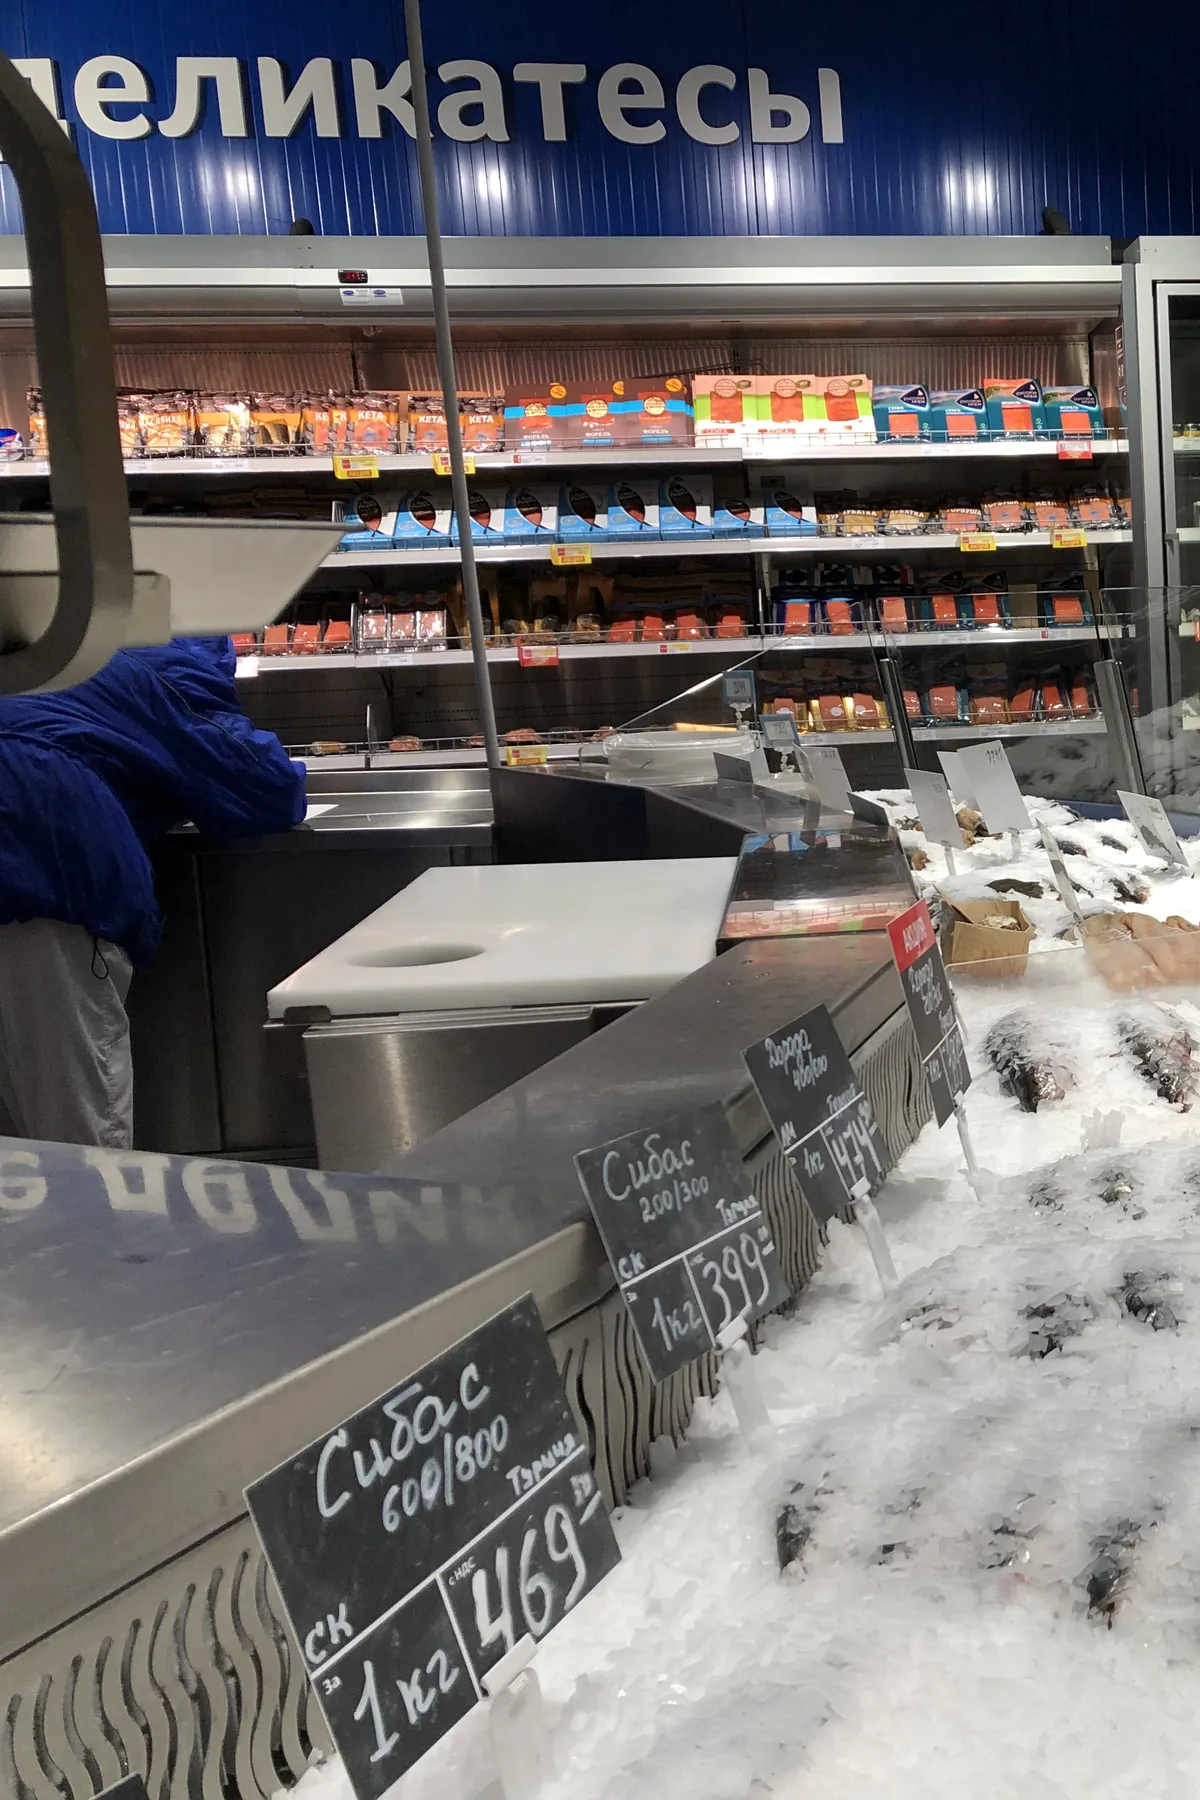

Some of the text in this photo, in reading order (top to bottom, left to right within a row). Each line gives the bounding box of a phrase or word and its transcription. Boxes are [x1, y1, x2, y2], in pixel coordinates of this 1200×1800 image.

[358, 410, 384, 421] КЕТА
[418, 415, 444, 424] КЕТА
[468, 415, 494, 424] КЕТА
[764, 1028, 812, 1075] Дорада
[602, 1132, 695, 1201] Сибас
[638, 1175, 710, 1224] 200/300
[702, 1232, 770, 1331] 399
[316, 1362, 491, 1518] Сибас
[505, 1432, 578, 1496] Турция
[382, 1413, 510, 1533] 600/800
[454, 1555, 477, 1581] НДС
[471, 1502, 587, 1651] 469
[321, 1674, 342, 1696] За
